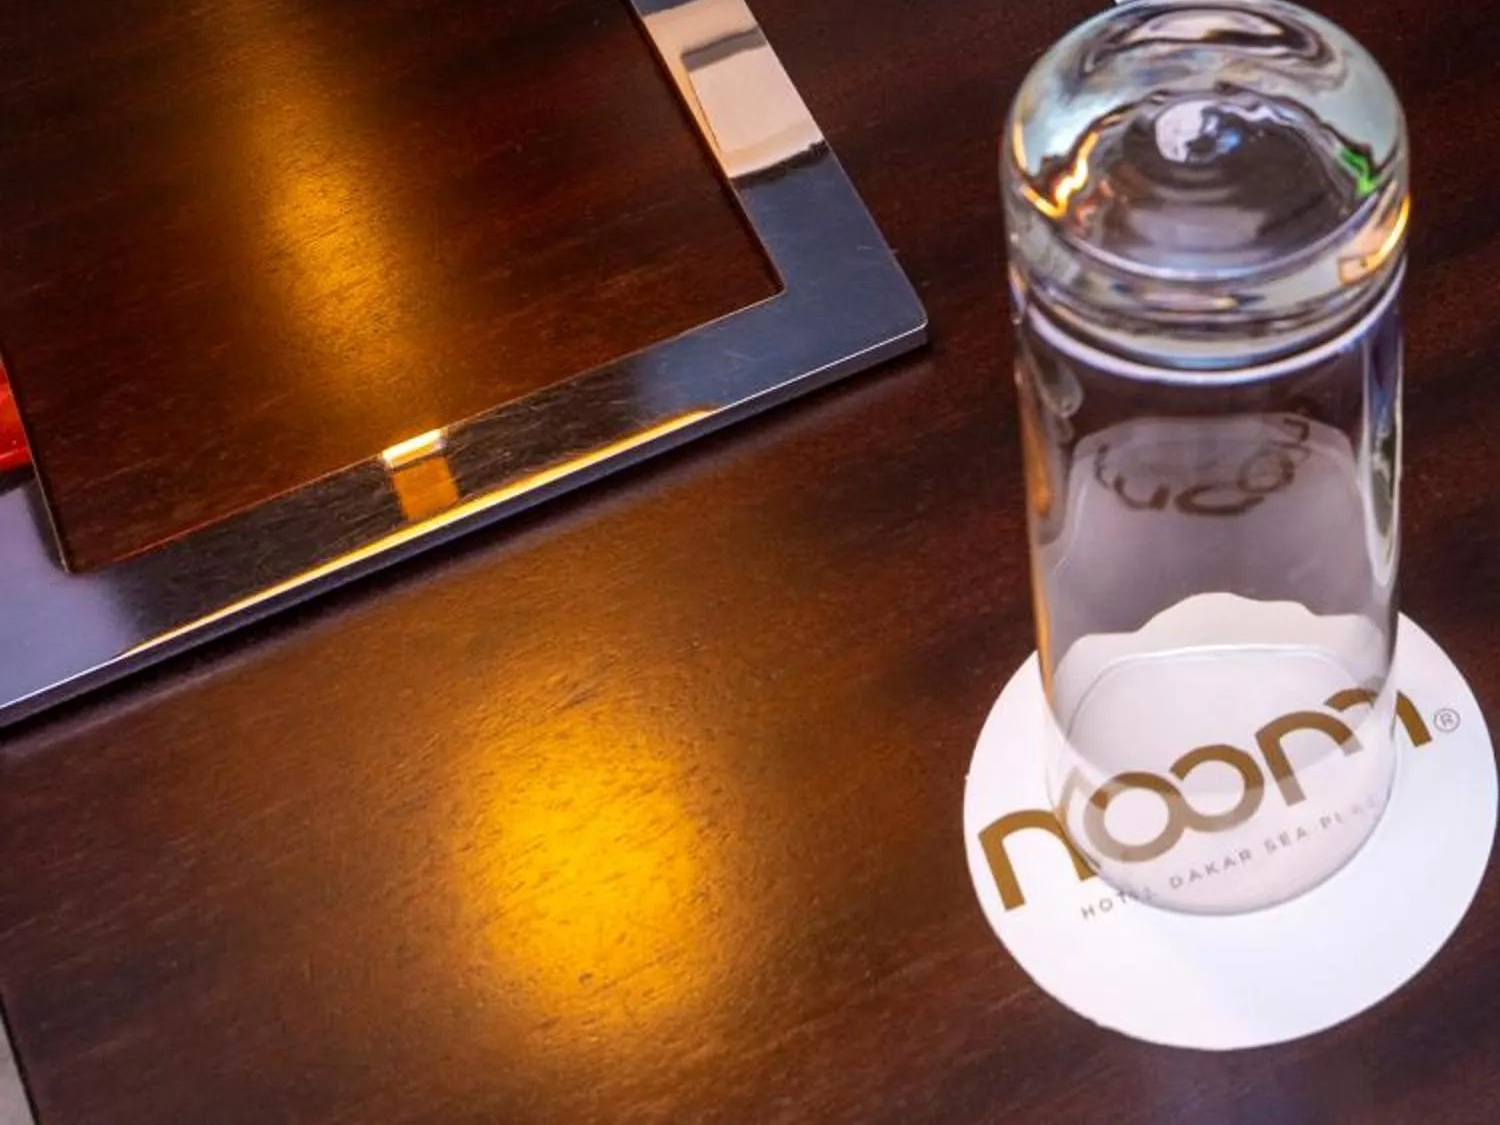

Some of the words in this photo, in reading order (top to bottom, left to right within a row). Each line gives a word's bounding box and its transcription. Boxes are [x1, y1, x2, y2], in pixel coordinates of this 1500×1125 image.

[978, 687, 1433, 912] noom
[1168, 847, 1253, 890] DAKAR
[1263, 825, 1309, 855] SEA
